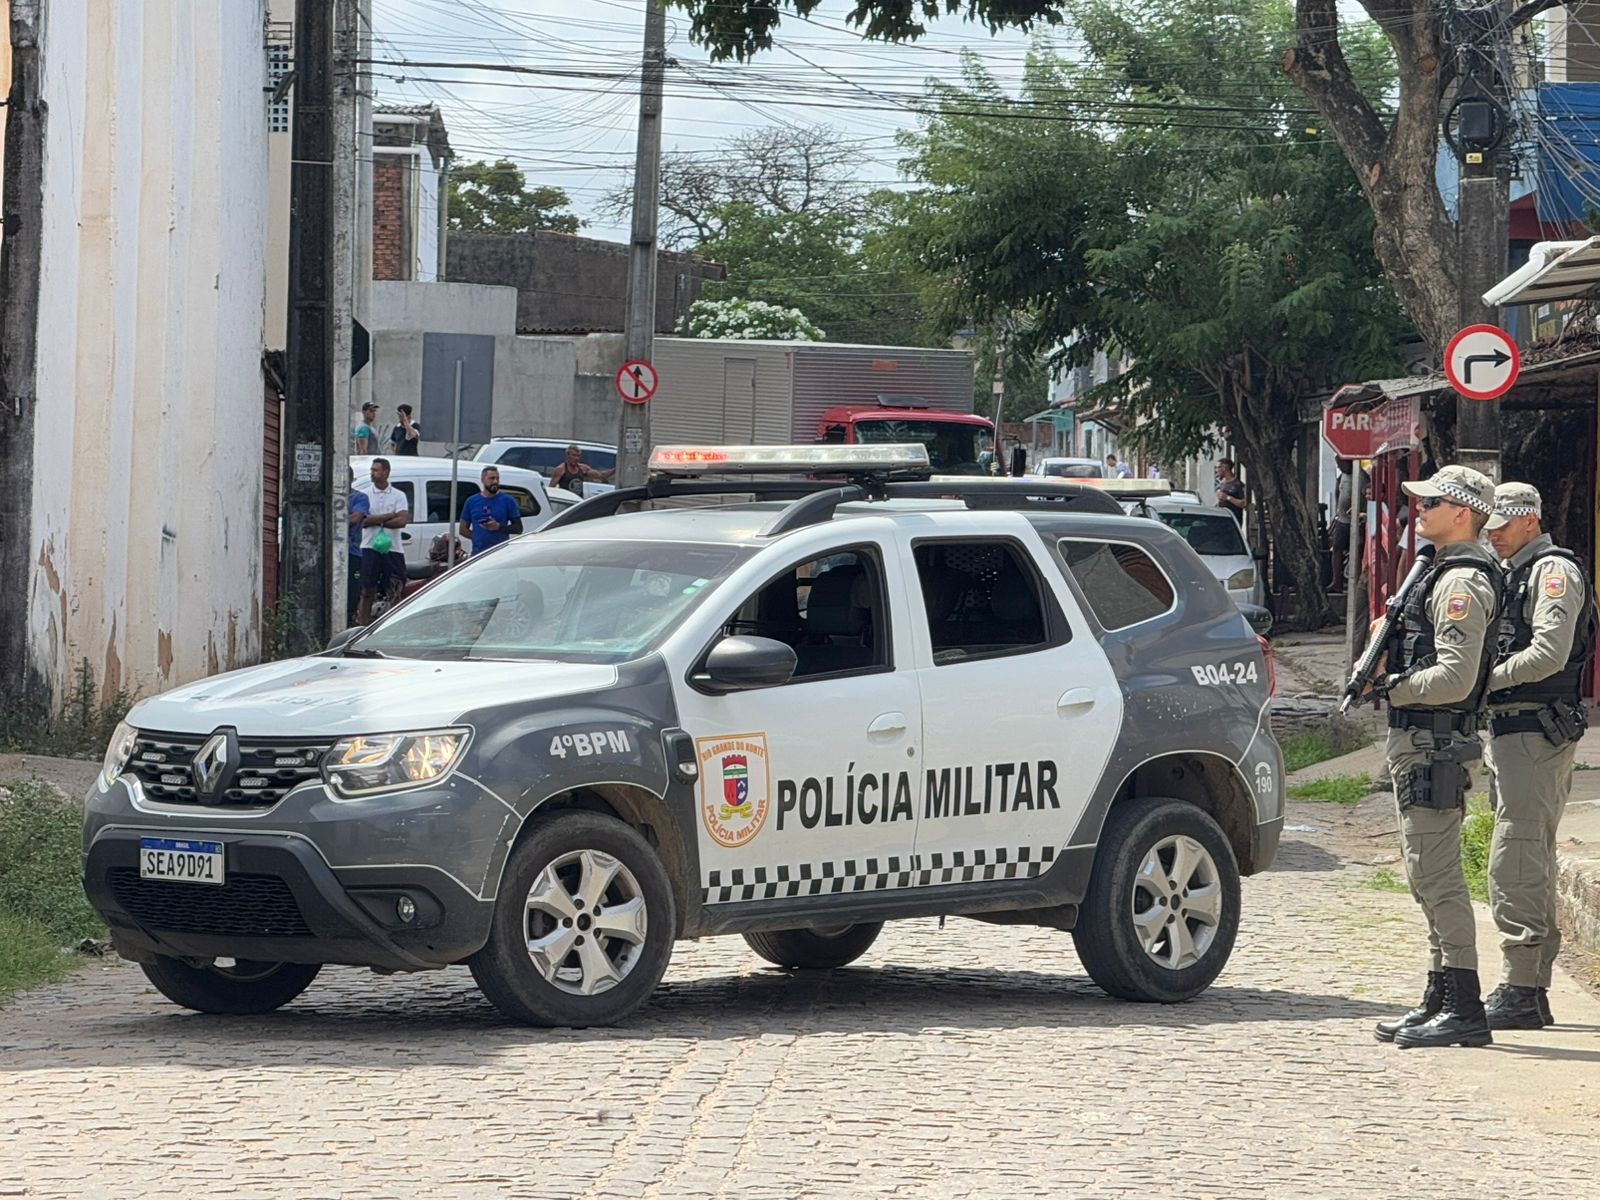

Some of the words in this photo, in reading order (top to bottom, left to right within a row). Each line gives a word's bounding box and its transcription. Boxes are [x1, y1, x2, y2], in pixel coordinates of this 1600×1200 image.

[1191, 661, 1258, 686] B04-24
[776, 761, 914, 831] POLÍCIA
[924, 759, 1061, 819] MILITAR
[1255, 776, 1273, 793] 190
[706, 804, 734, 841] POLÍCIA
[736, 799, 766, 841] MILITAR
[147, 852, 213, 878] SEA9D91
